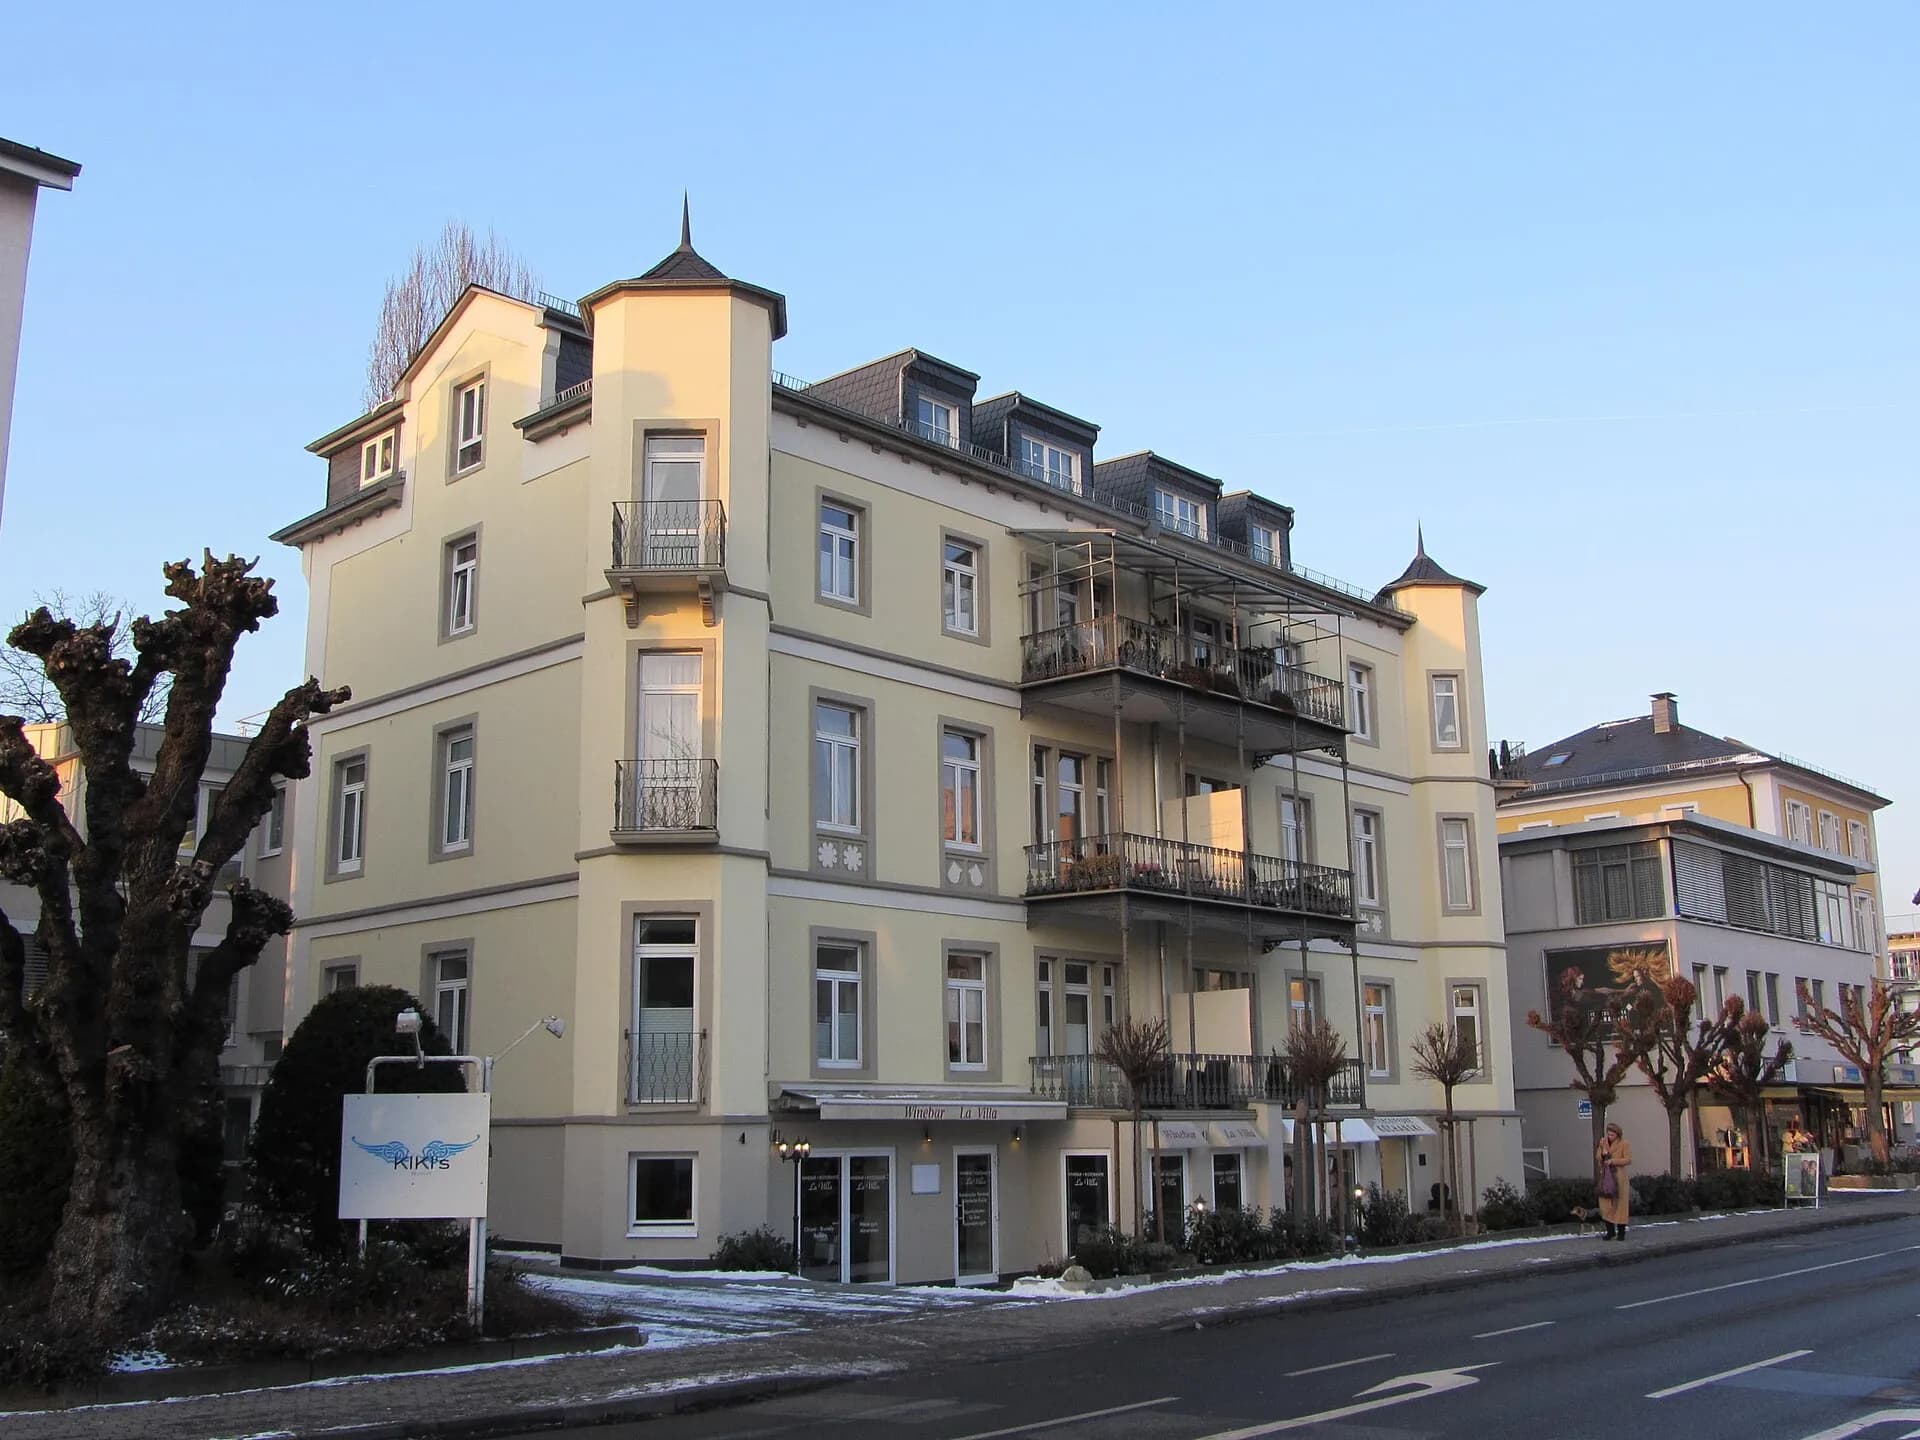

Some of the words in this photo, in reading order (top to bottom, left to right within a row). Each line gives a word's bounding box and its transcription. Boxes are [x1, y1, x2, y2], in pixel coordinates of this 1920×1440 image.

[905, 1106, 945, 1119] Winebar
[959, 1107, 972, 1119] La
[977, 1107, 998, 1119] Villa
